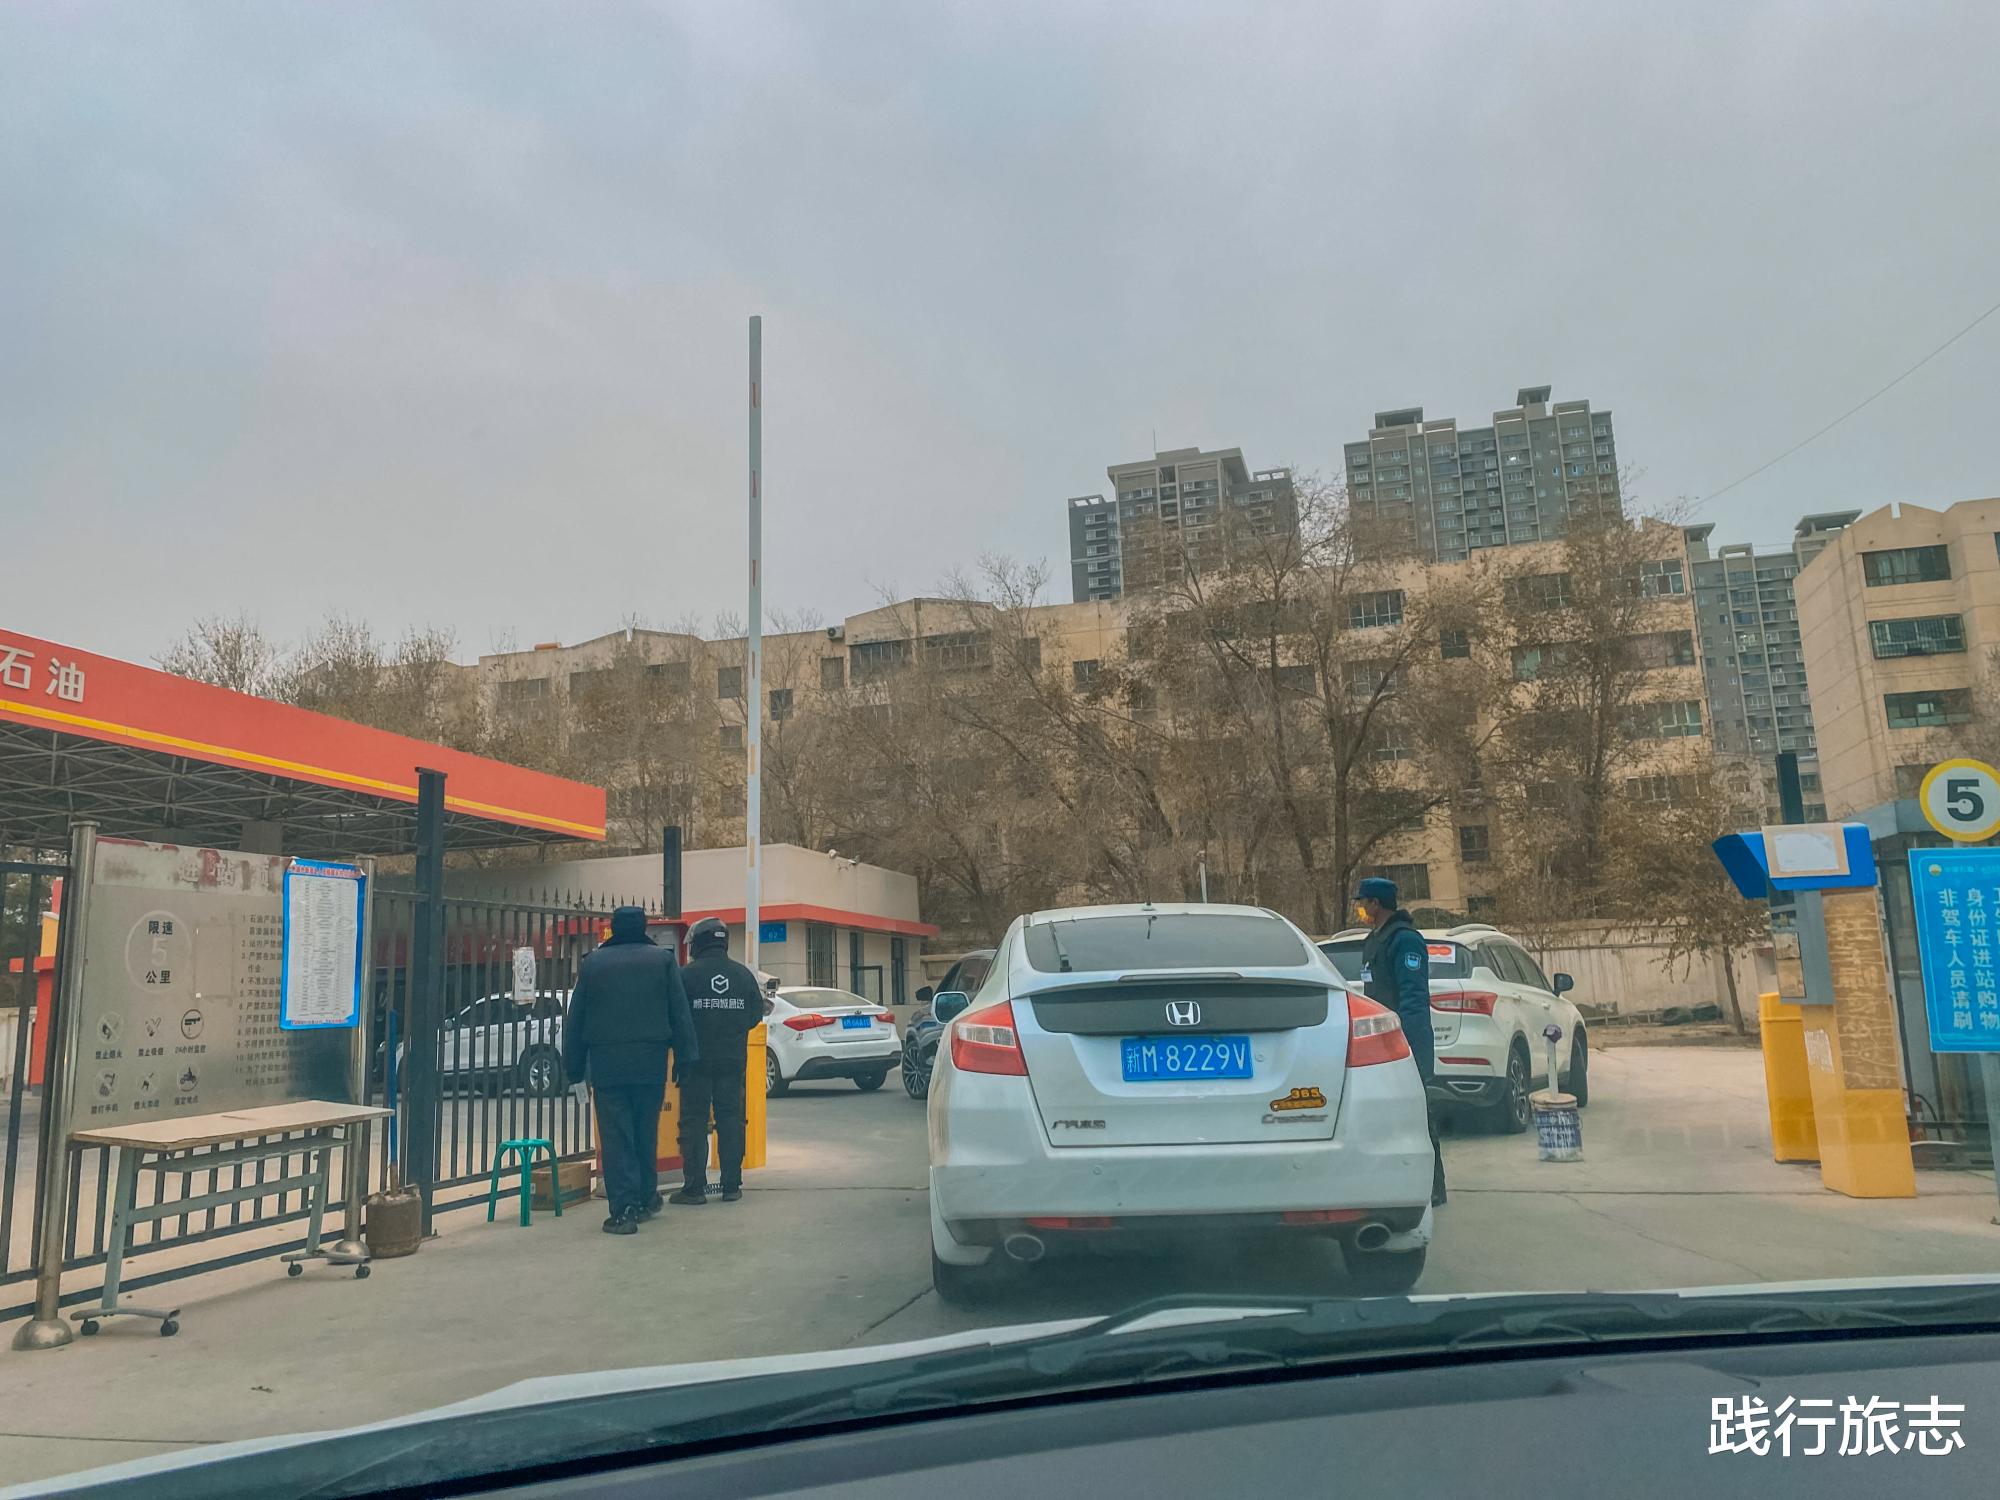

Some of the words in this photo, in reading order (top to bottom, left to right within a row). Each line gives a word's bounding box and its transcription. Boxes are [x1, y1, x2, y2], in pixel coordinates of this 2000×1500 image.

[0, 643, 86, 704] 石油
[1947, 779, 1985, 822] 5
[148, 920, 173, 935] 限速
[151, 937, 168, 967] 5
[1938, 888, 1974, 1031] 非驾车人员请刷
[1966, 888, 2000, 1031] 身份证进站购物
[145, 970, 171, 984] 公里
[693, 998, 745, 1009] 顺丰同城急送
